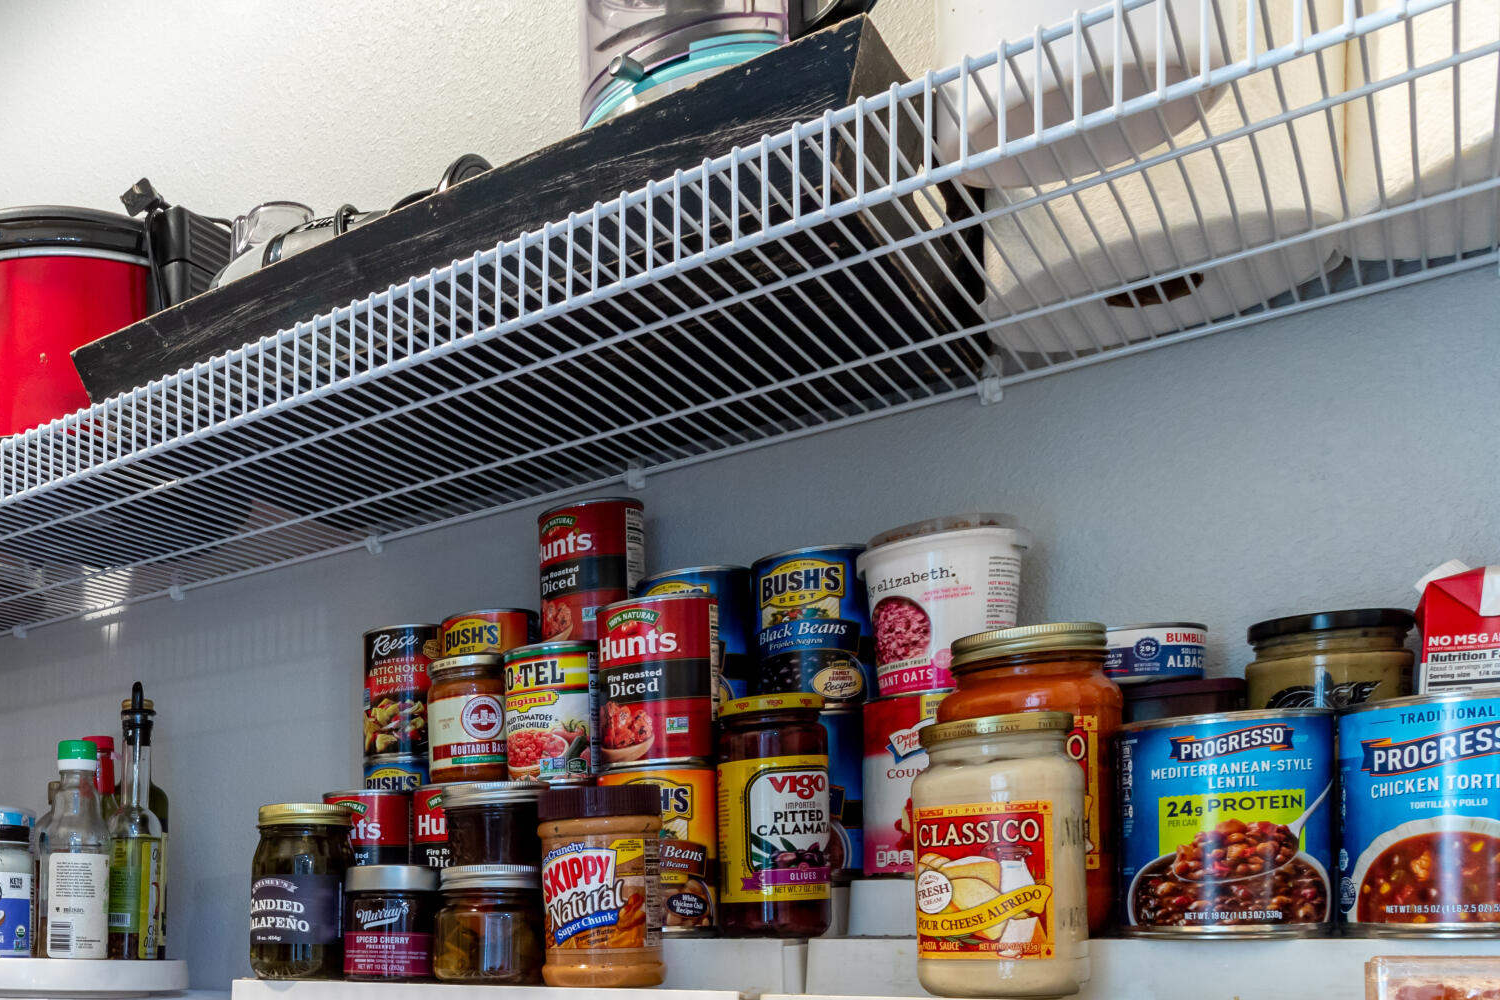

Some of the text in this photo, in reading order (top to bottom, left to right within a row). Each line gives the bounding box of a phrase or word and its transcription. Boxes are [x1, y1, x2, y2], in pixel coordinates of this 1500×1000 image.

[550, 565, 579, 579] Roasted
[541, 574, 577, 596] Diced
[760, 566, 842, 603] BUSH'S
[779, 592, 816, 604] BEST
[609, 610, 655, 628] 100% NATURAL
[444, 624, 500, 648] BUSH'S
[759, 620, 848, 646] Black Beans
[1428, 633, 1488, 647] NO MSG
[371, 634, 418, 659] Reese
[459, 646, 476, 655] BEST
[769, 636, 824, 651] Frijoles Negros
[374, 656, 415, 666] QUARTERED
[910, 658, 927, 666] FRUIT
[1430, 651, 1487, 663] Nutrition
[369, 663, 425, 678] ARTICHOKE
[607, 668, 663, 684] Fire Roasted
[902, 669, 934, 684] OATS
[1429, 673, 1455, 681] Serving
[376, 673, 414, 686] HEARTS
[609, 677, 660, 698] Diced
[516, 713, 553, 724] TOMATOES
[1400, 705, 1496, 726] TRADITIONAL
[525, 720, 550, 730] CHILIES
[995, 724, 1021, 733] ITALY
[450, 742, 491, 756] MOUTARDE
[1180, 726, 1285, 761] PROGRESSO
[1151, 758, 1313, 781] MEDITERRANEAN-STYLE
[1208, 775, 1259, 790] LENTIL
[1371, 776, 1439, 799] CHICKEN
[785, 800, 816, 809] IMPORTED
[965, 806, 1000, 815] PARMA
[1207, 794, 1302, 814] PROTEIN
[1410, 797, 1488, 810] TORTILLA POLLO
[773, 809, 824, 824] PITTED
[1168, 818, 1198, 828] PER CAN
[918, 818, 1040, 848] CLASSICO
[548, 842, 585, 861] Crunchy
[664, 844, 704, 863] Beans
[543, 855, 610, 904] SKIPPY
[789, 872, 817, 881] OLIVES
[918, 882, 950, 901] FRESH
[549, 878, 625, 932] Natural
[923, 896, 943, 907] CREAM
[988, 888, 1042, 920] ALFREDO
[1385, 904, 1441, 914] NET OZ
[356, 903, 410, 930] Murray's
[918, 912, 988, 931] FOUR CHEESE
[1185, 911, 1230, 920] NET OZ
[557, 911, 615, 941] Super Chunk
[356, 936, 410, 944] SPICED CHERRY
[938, 940, 960, 950] SAUCE
